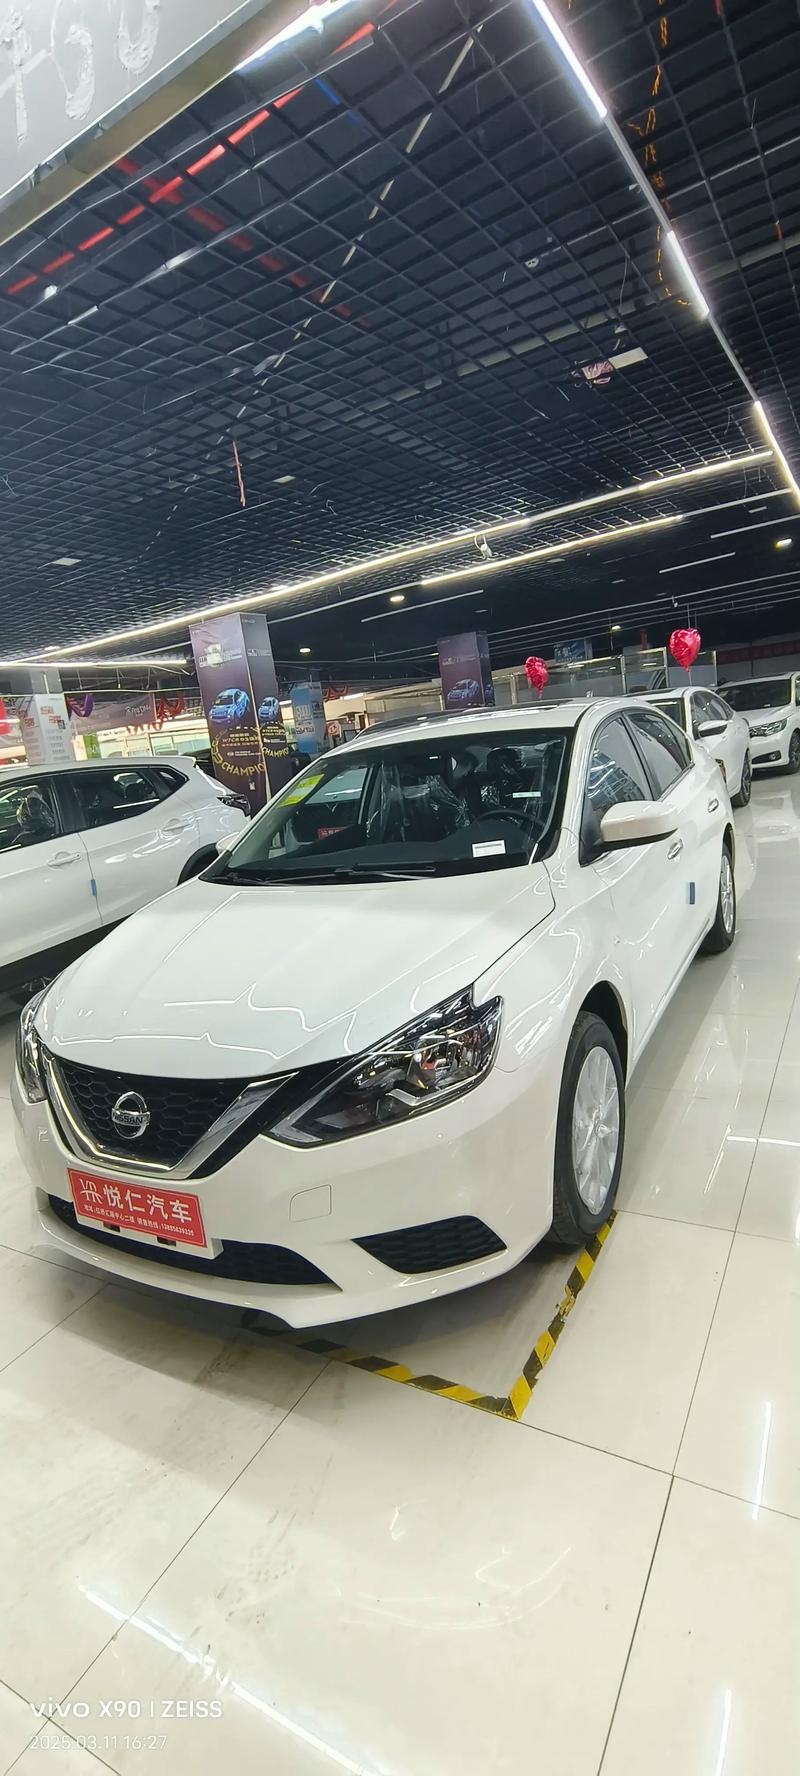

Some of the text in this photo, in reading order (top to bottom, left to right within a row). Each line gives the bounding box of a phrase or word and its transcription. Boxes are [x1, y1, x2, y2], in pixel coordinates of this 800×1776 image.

[114, 1113, 144, 1124] NISSAN
[104, 1184, 192, 1223] 悦仁汽车
